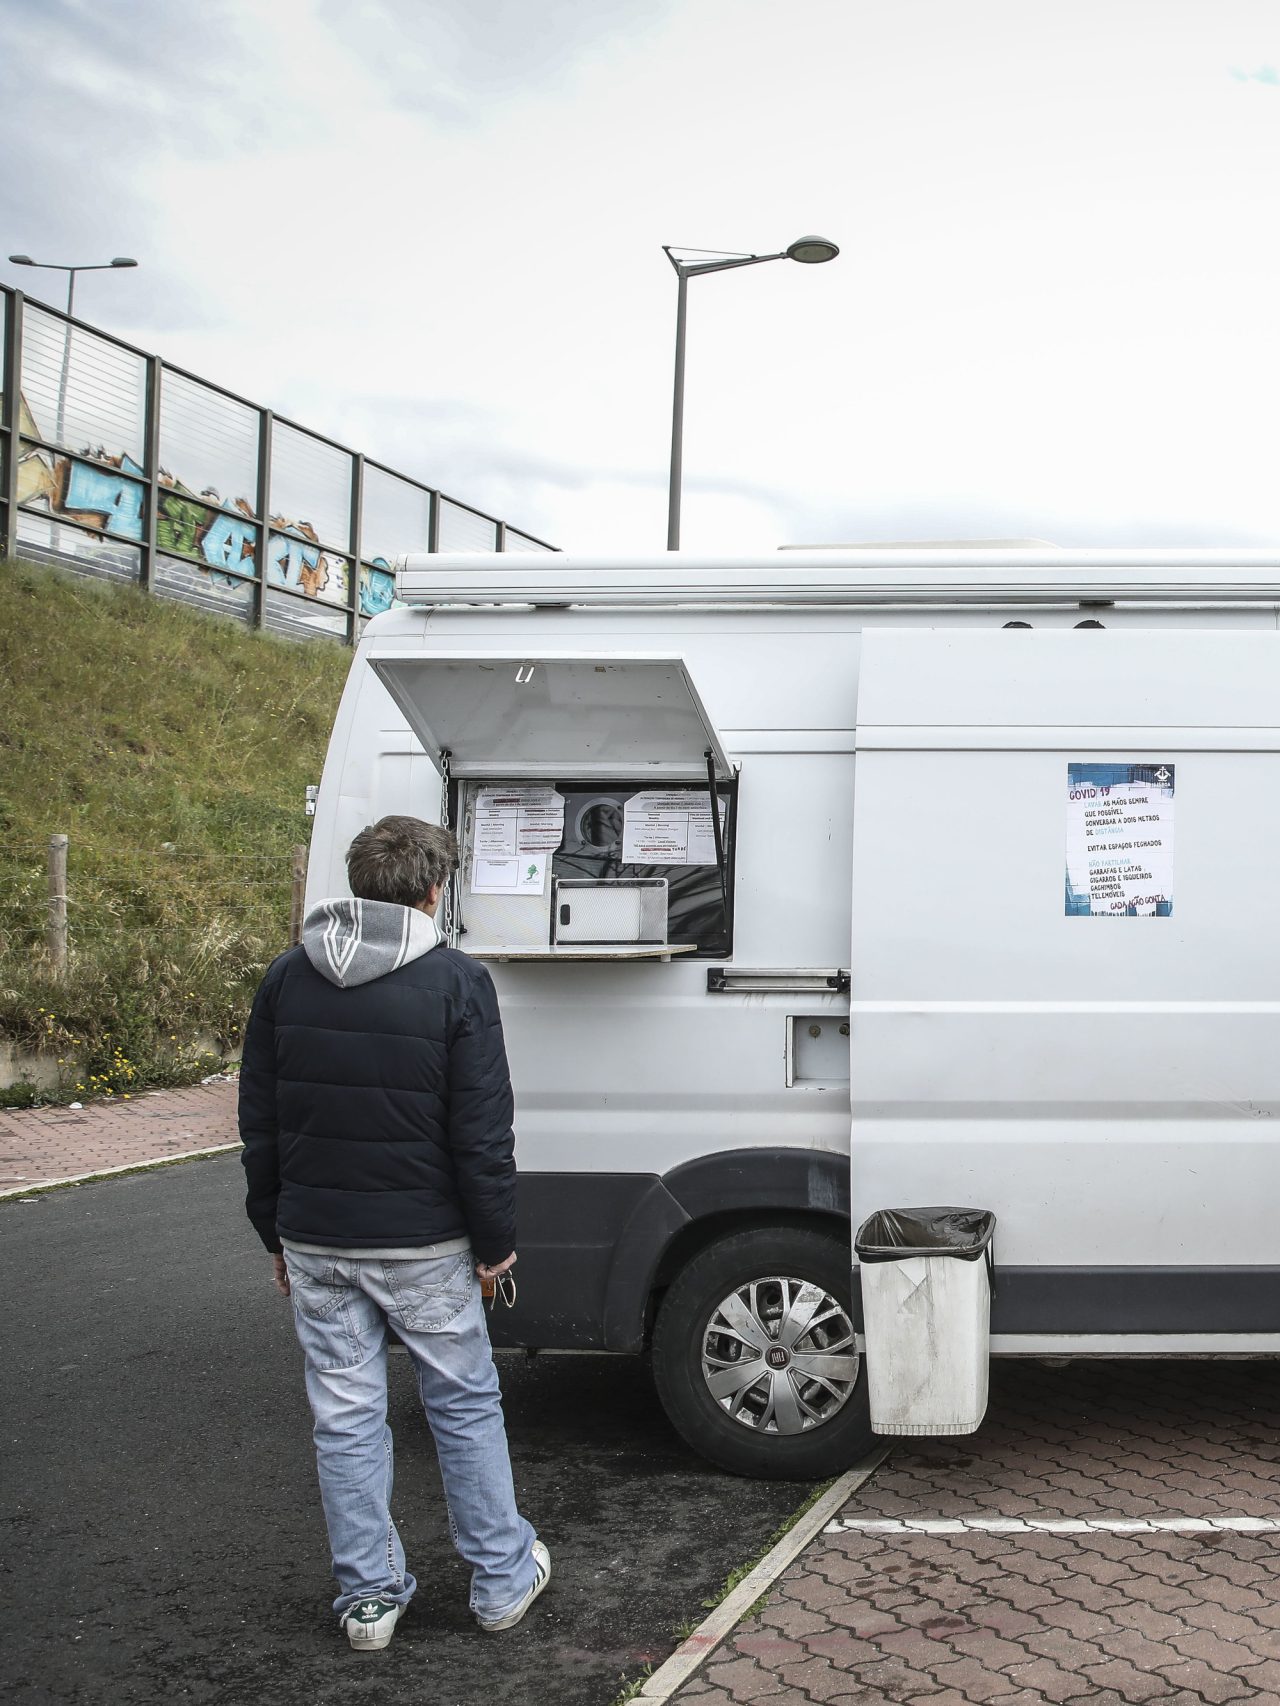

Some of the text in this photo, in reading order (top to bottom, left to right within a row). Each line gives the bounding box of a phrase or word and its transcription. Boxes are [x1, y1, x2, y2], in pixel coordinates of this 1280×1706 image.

[1069, 786, 1110, 800] COVID 19
[1111, 797, 1127, 806] MÃOS
[1128, 796, 1149, 805] SEMPRE
[1084, 807, 1123, 818] QUE POSSÍVEL
[1085, 818, 1117, 827] CONVERSAR
[1123, 816, 1137, 824] DOIS
[1137, 814, 1160, 823] METROS
[1087, 839, 1162, 852] EVITAR ESPAÇOS FECHADOS
[1089, 867, 1117, 876] GARRAFAS
[1123, 865, 1142, 873] LATAS
[1089, 875, 1116, 884] CIGARROS
[1090, 883, 1121, 892] CACHIMBOS
[1091, 889, 1126, 900] TELEMÓVEIS
[1110, 900, 1127, 911] CADA
[1144, 894, 1166, 905] CONTA
